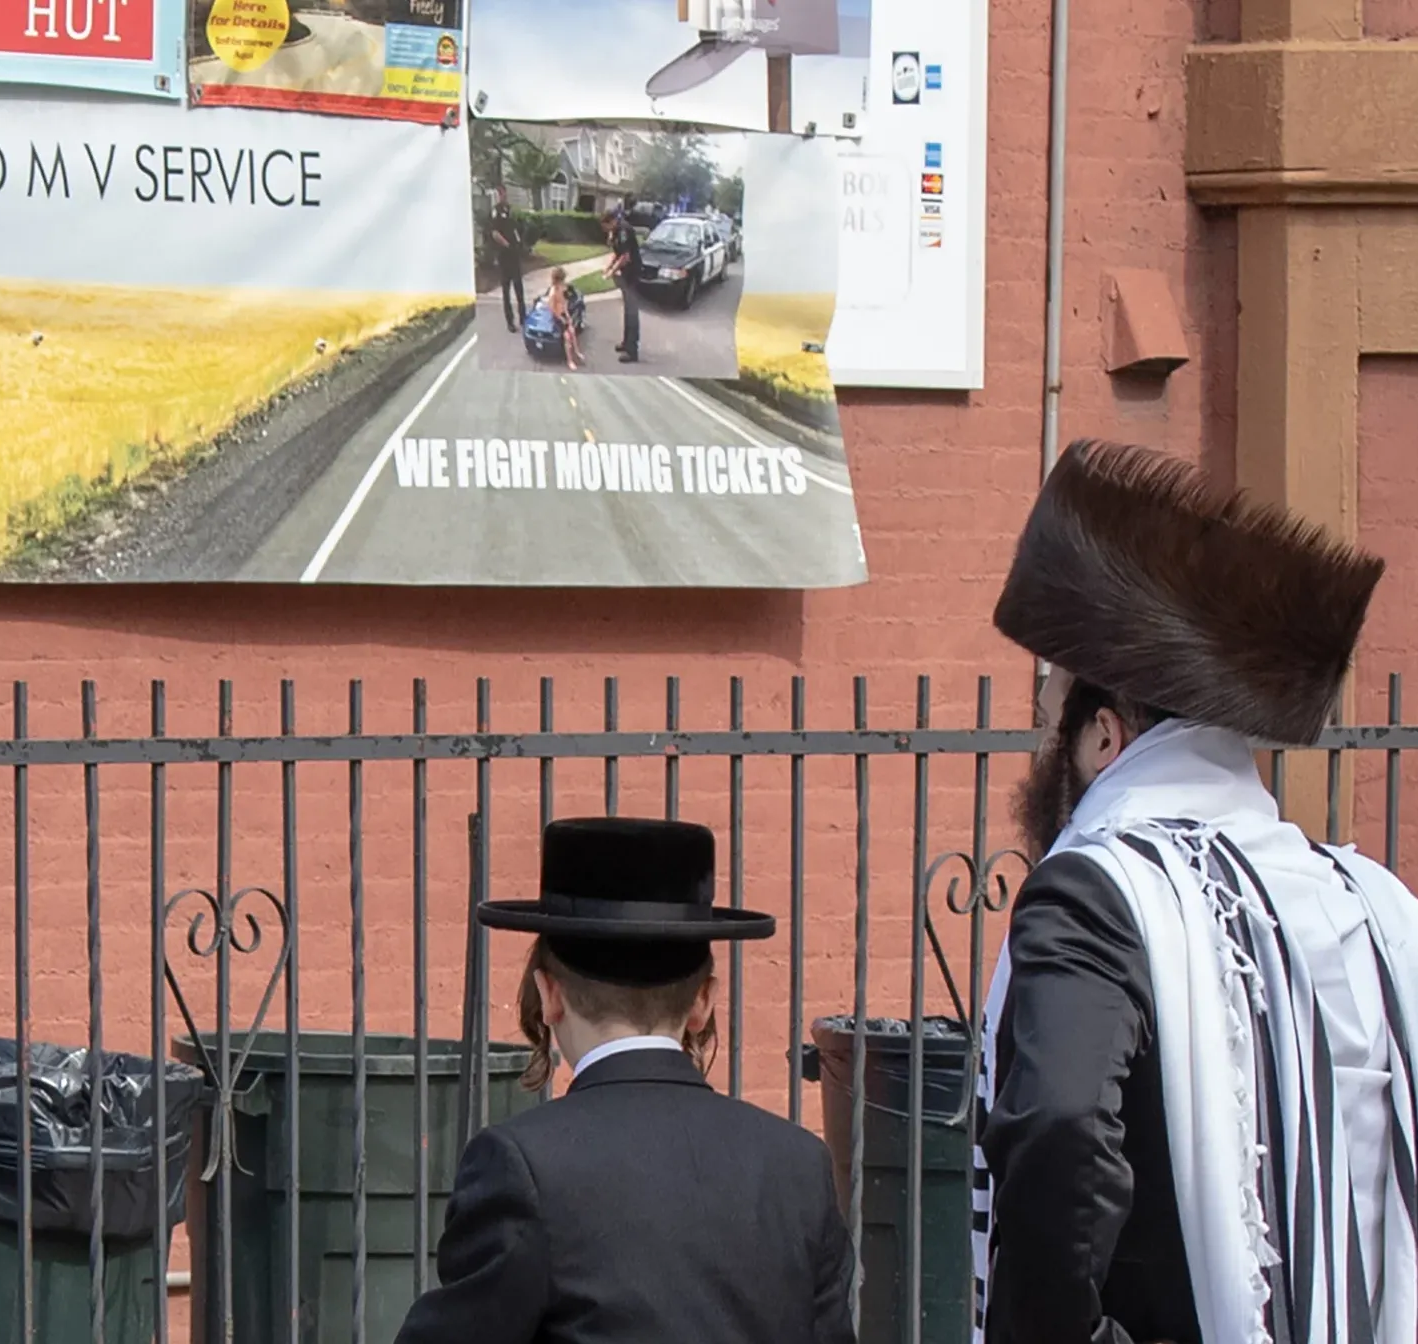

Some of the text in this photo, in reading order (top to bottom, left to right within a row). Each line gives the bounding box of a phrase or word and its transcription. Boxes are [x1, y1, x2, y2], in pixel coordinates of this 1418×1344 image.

[23, 0, 128, 42] HUT
[210, 14, 286, 30] for Details
[134, 144, 322, 207] SERVICE
[393, 438, 809, 497] WE FIGHT MOVING TICKETS
